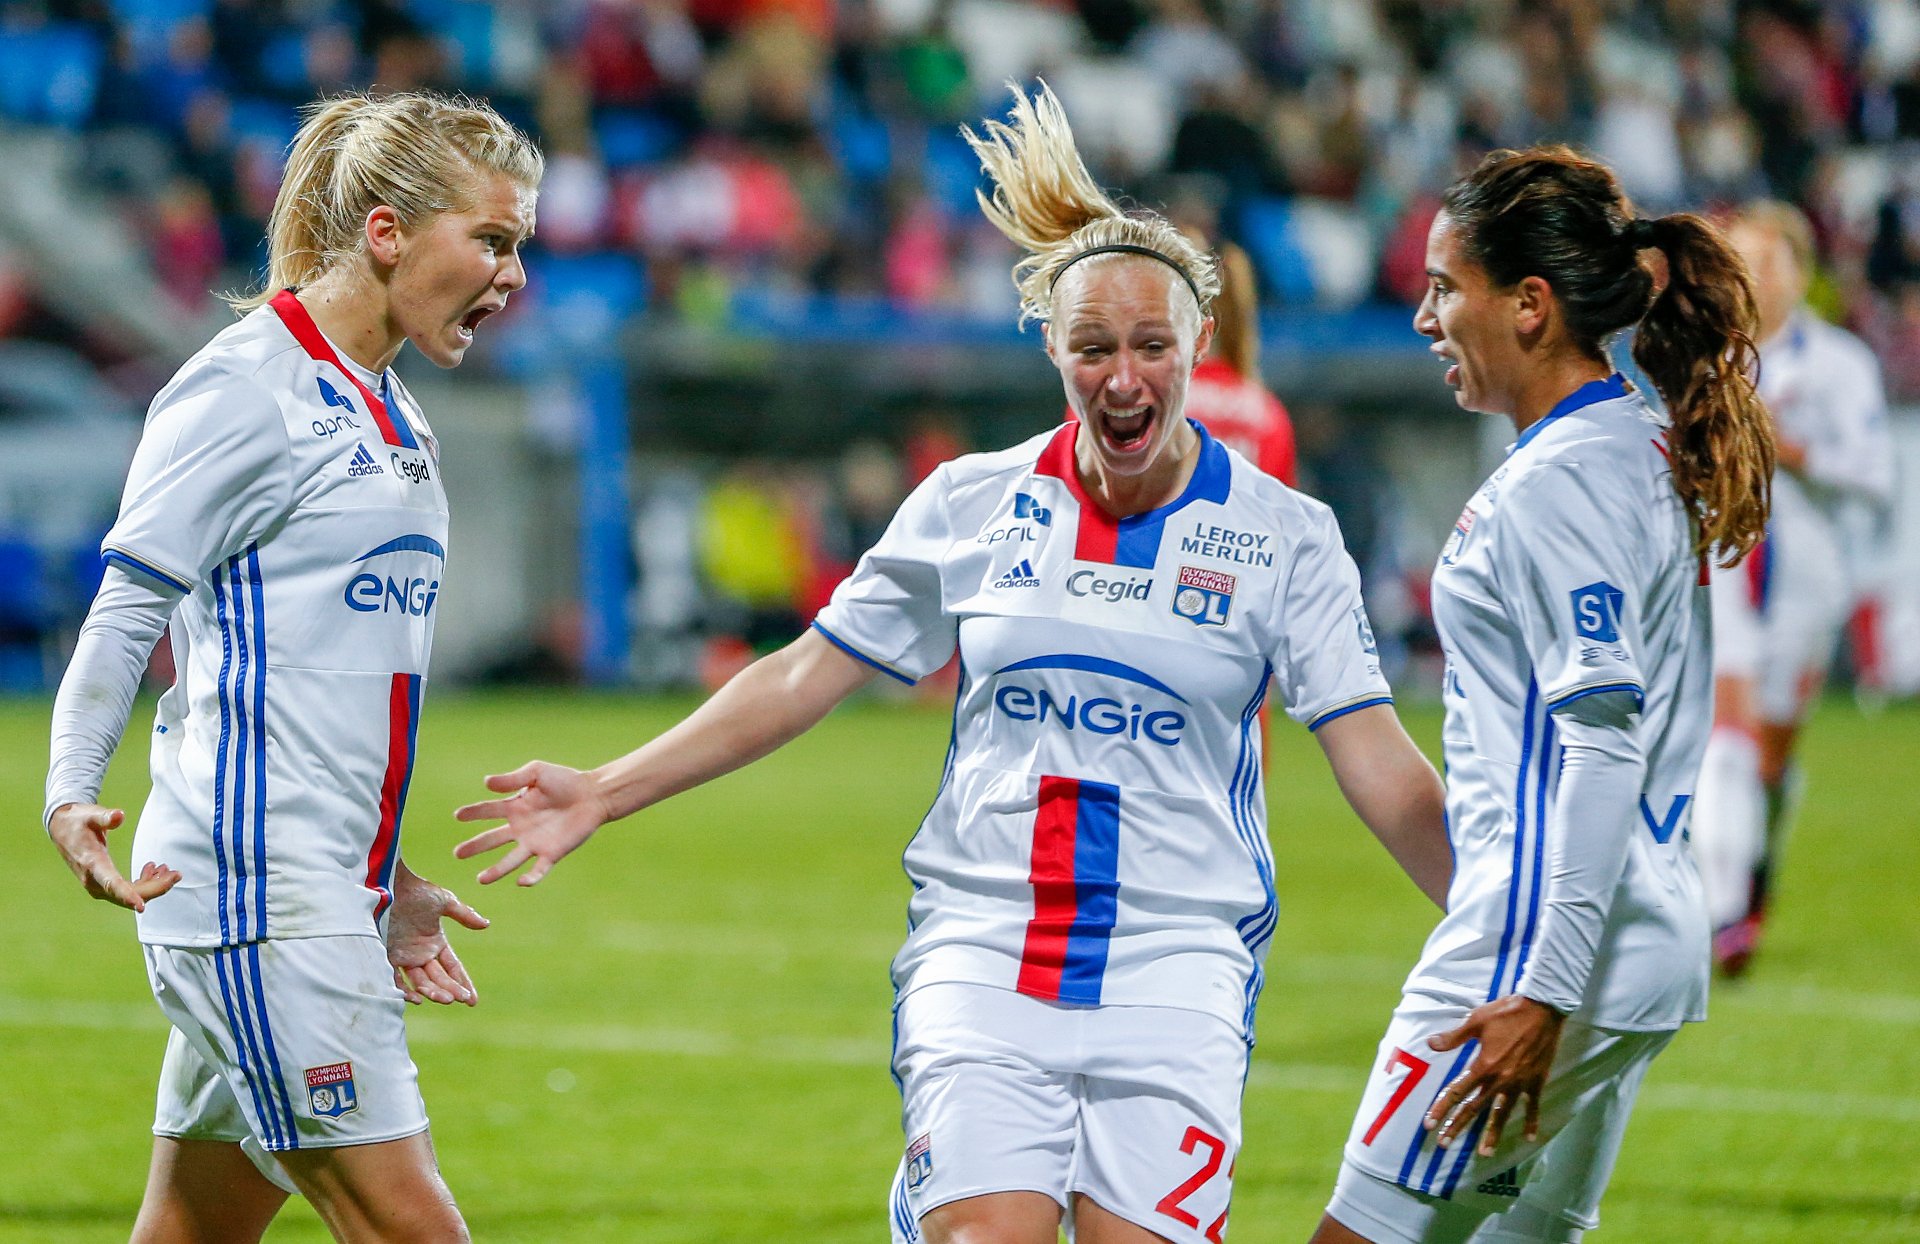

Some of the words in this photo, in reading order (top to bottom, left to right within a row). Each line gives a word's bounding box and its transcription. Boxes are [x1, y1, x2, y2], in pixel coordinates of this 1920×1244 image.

[312, 415, 361, 440] april
[347, 462, 384, 477] adidas
[390, 452, 430, 484] Cegid
[977, 526, 1037, 546] april
[1195, 522, 1269, 549] LEROY
[1180, 536, 1274, 568] MERLIN
[994, 577, 1041, 589] adidas
[1066, 569, 1154, 603] Cegid
[1180, 575, 1233, 594] LYONNAIS
[1181, 567, 1235, 585] OLYMPIQUE
[306, 1063, 349, 1078] OLYMPIQUE
[307, 1070, 351, 1085] LYONNAIS
[1361, 1046, 1431, 1148] 7
